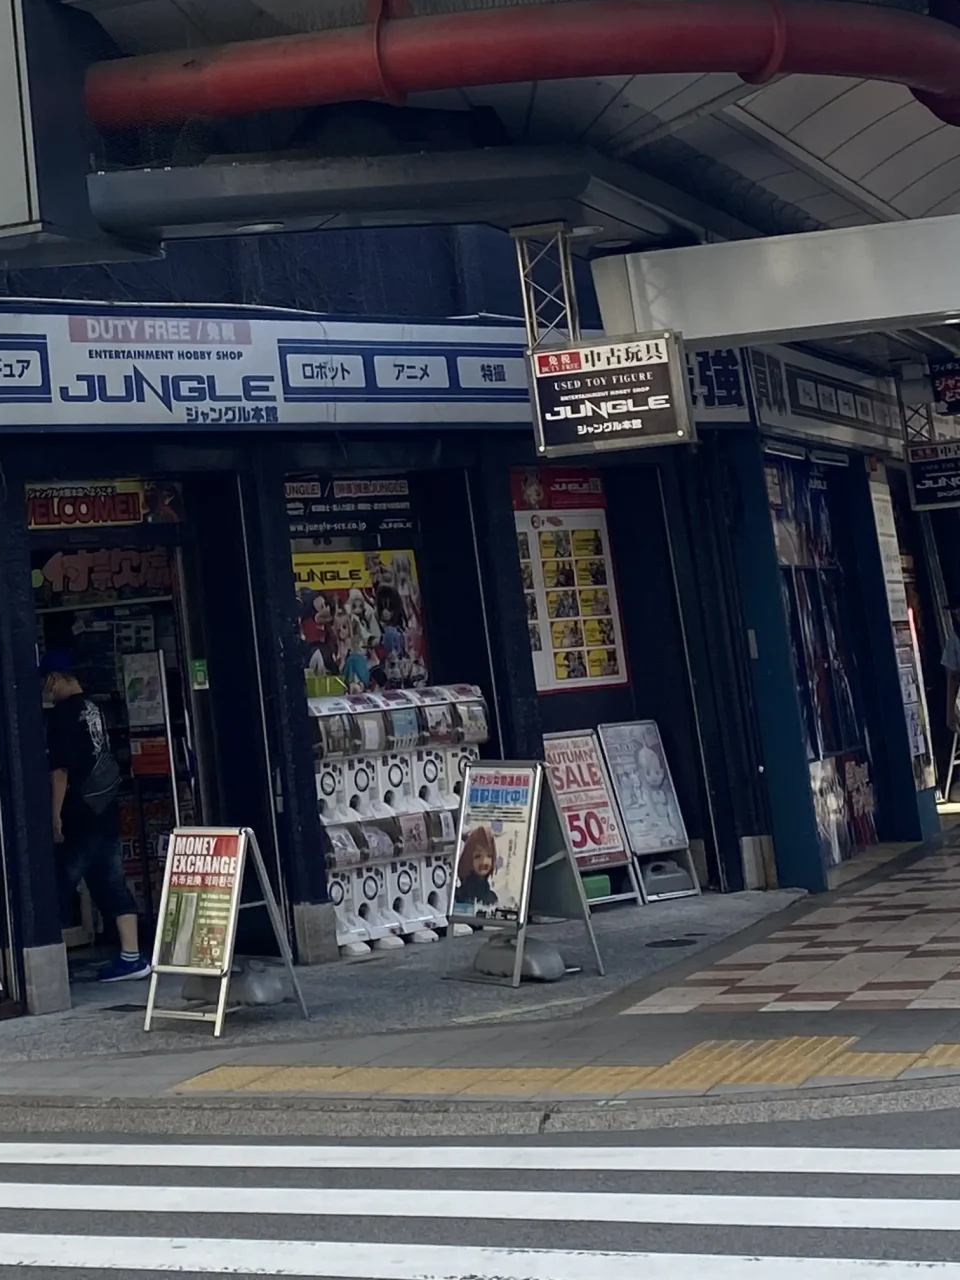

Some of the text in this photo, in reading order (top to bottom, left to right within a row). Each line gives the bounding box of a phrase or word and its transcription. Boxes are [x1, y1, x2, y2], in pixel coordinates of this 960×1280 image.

[85, 317, 139, 341] DUTY
[143, 318, 192, 341] FREE
[87, 349, 244, 361] ENTERTAINMENT HOBBY SHOP
[584, 342, 664, 369] 中古玩具
[301, 361, 352, 381] ロボット
[393, 363, 431, 381] アニメ
[479, 363, 507, 382] 特撮
[58, 363, 278, 414] JUNGLE
[552, 371, 654, 392] USED TOY FIGURE
[185, 405, 279, 423] ジャングル本館
[544, 394, 671, 422] JUNGLE
[546, 751, 594, 766] AUTUMN
[551, 762, 602, 791] SALE
[175, 836, 218, 856] MONEY
[172, 855, 238, 874] EXCHANGE
